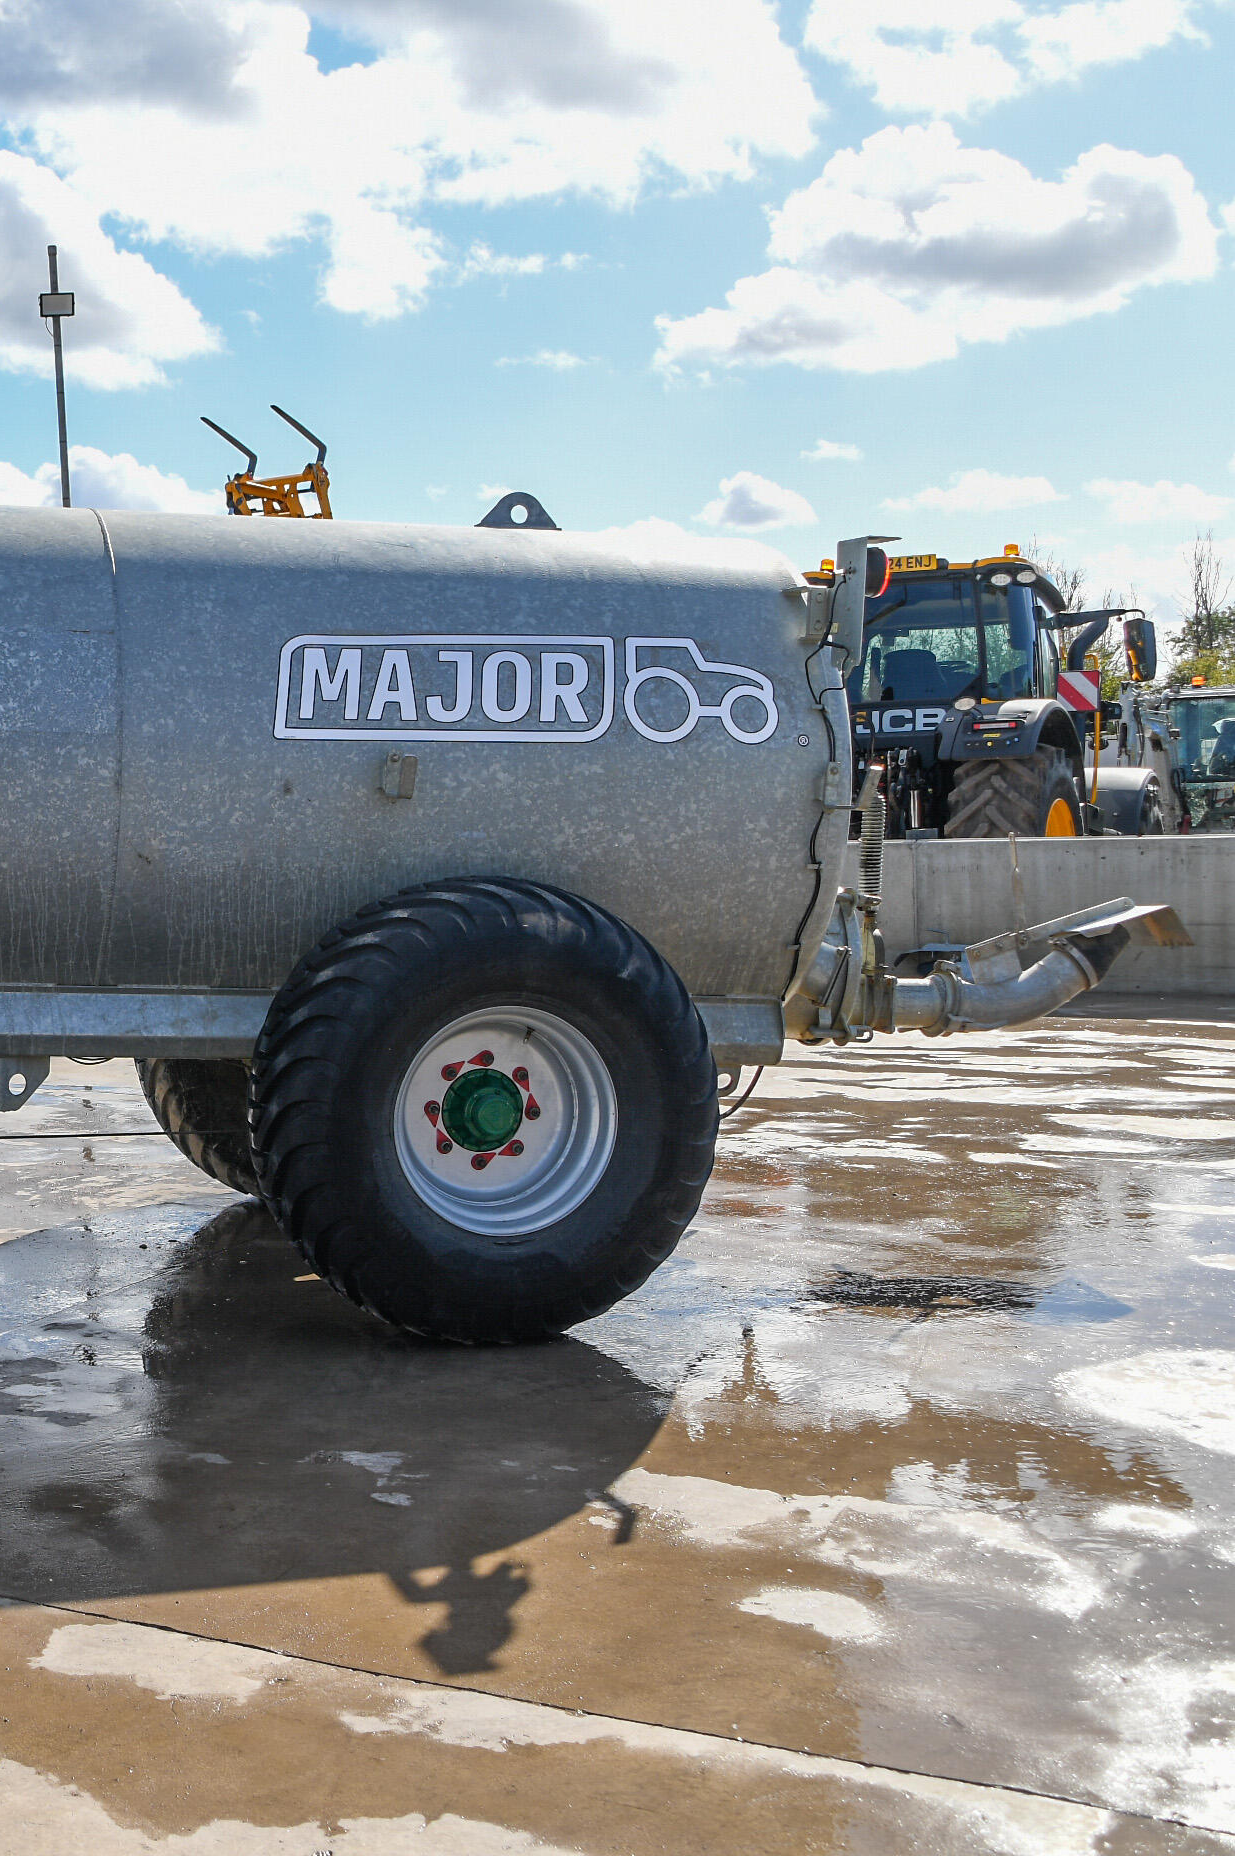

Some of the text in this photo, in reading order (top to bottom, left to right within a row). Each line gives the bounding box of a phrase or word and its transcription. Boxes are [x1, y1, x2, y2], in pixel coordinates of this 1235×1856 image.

[906, 556, 932, 569] ENJ
[298, 647, 590, 723] MAJOR
[855, 707, 947, 734] JCB
